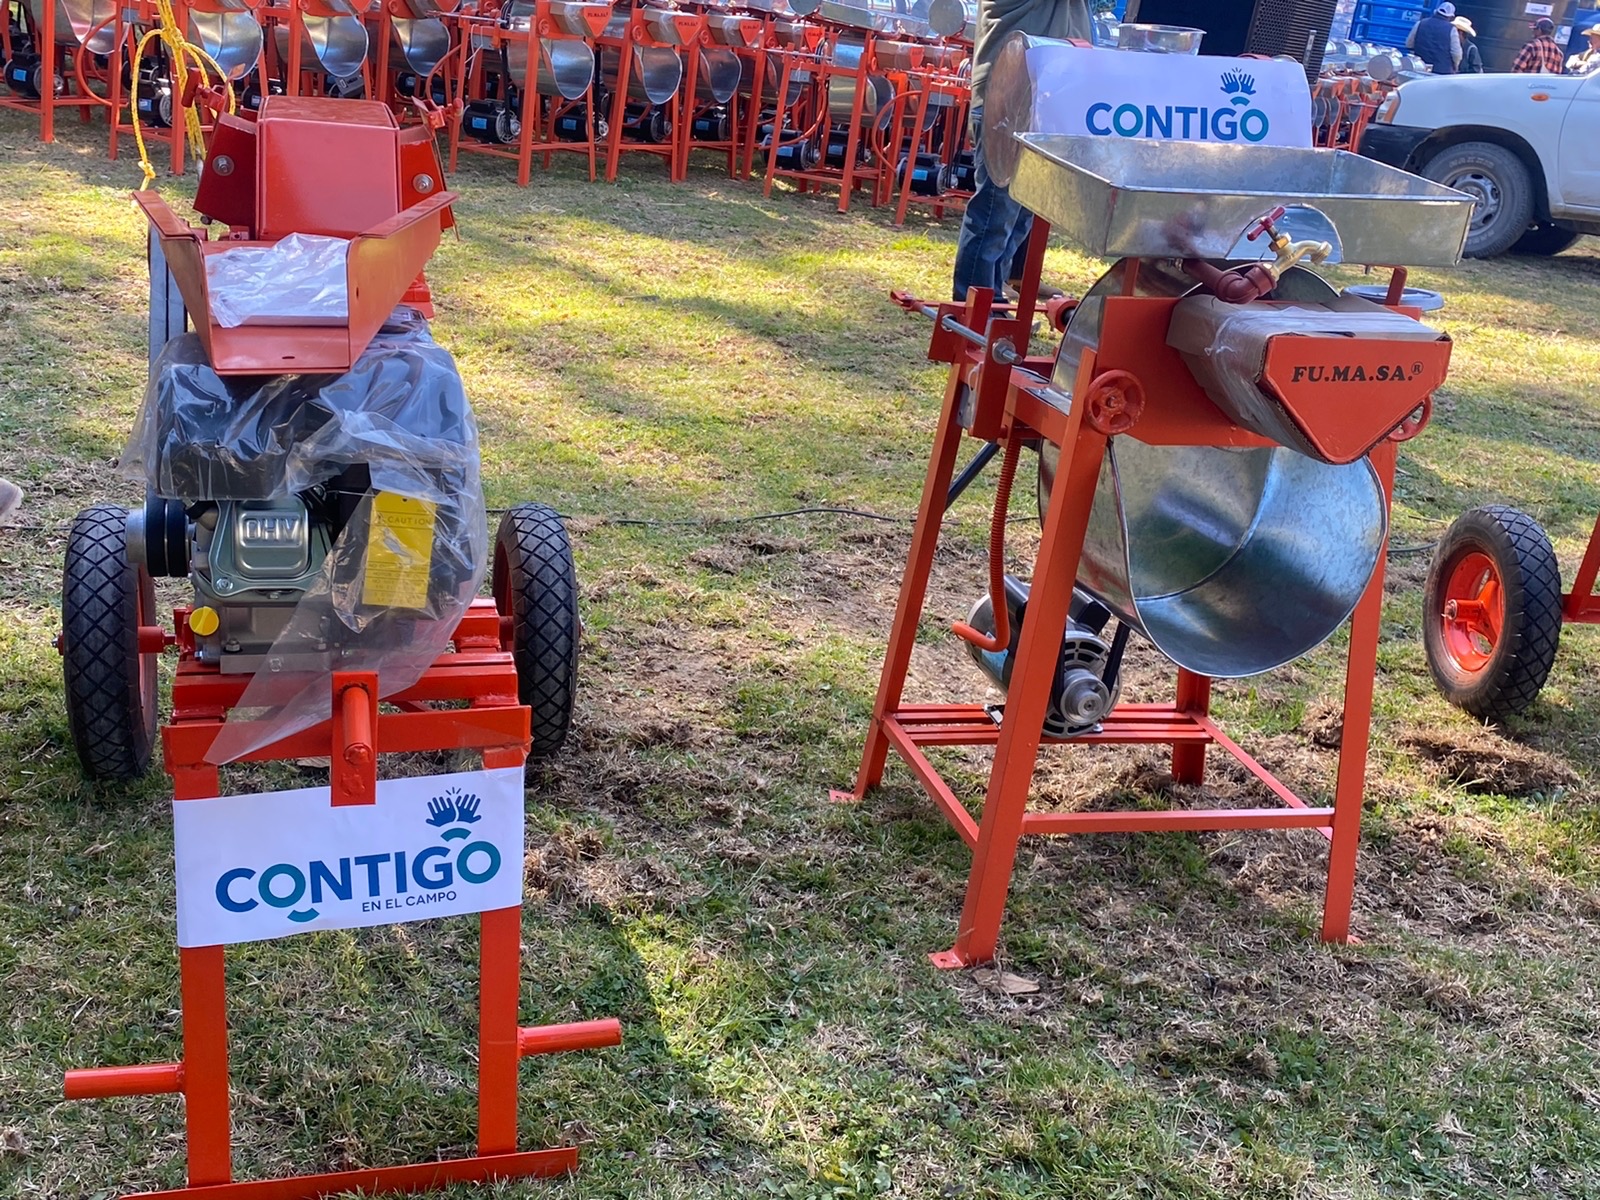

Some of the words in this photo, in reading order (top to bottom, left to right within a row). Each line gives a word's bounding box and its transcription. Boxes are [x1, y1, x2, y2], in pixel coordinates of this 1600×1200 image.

[1085, 102, 1269, 141] CONTIGO
[246, 518, 300, 540] OHV
[387, 515, 433, 526] CAUTION
[215, 840, 502, 913] CONTIGO
[361, 900, 381, 913] EN
[385, 898, 403, 910] EL
[405, 890, 457, 907] CAMPO
